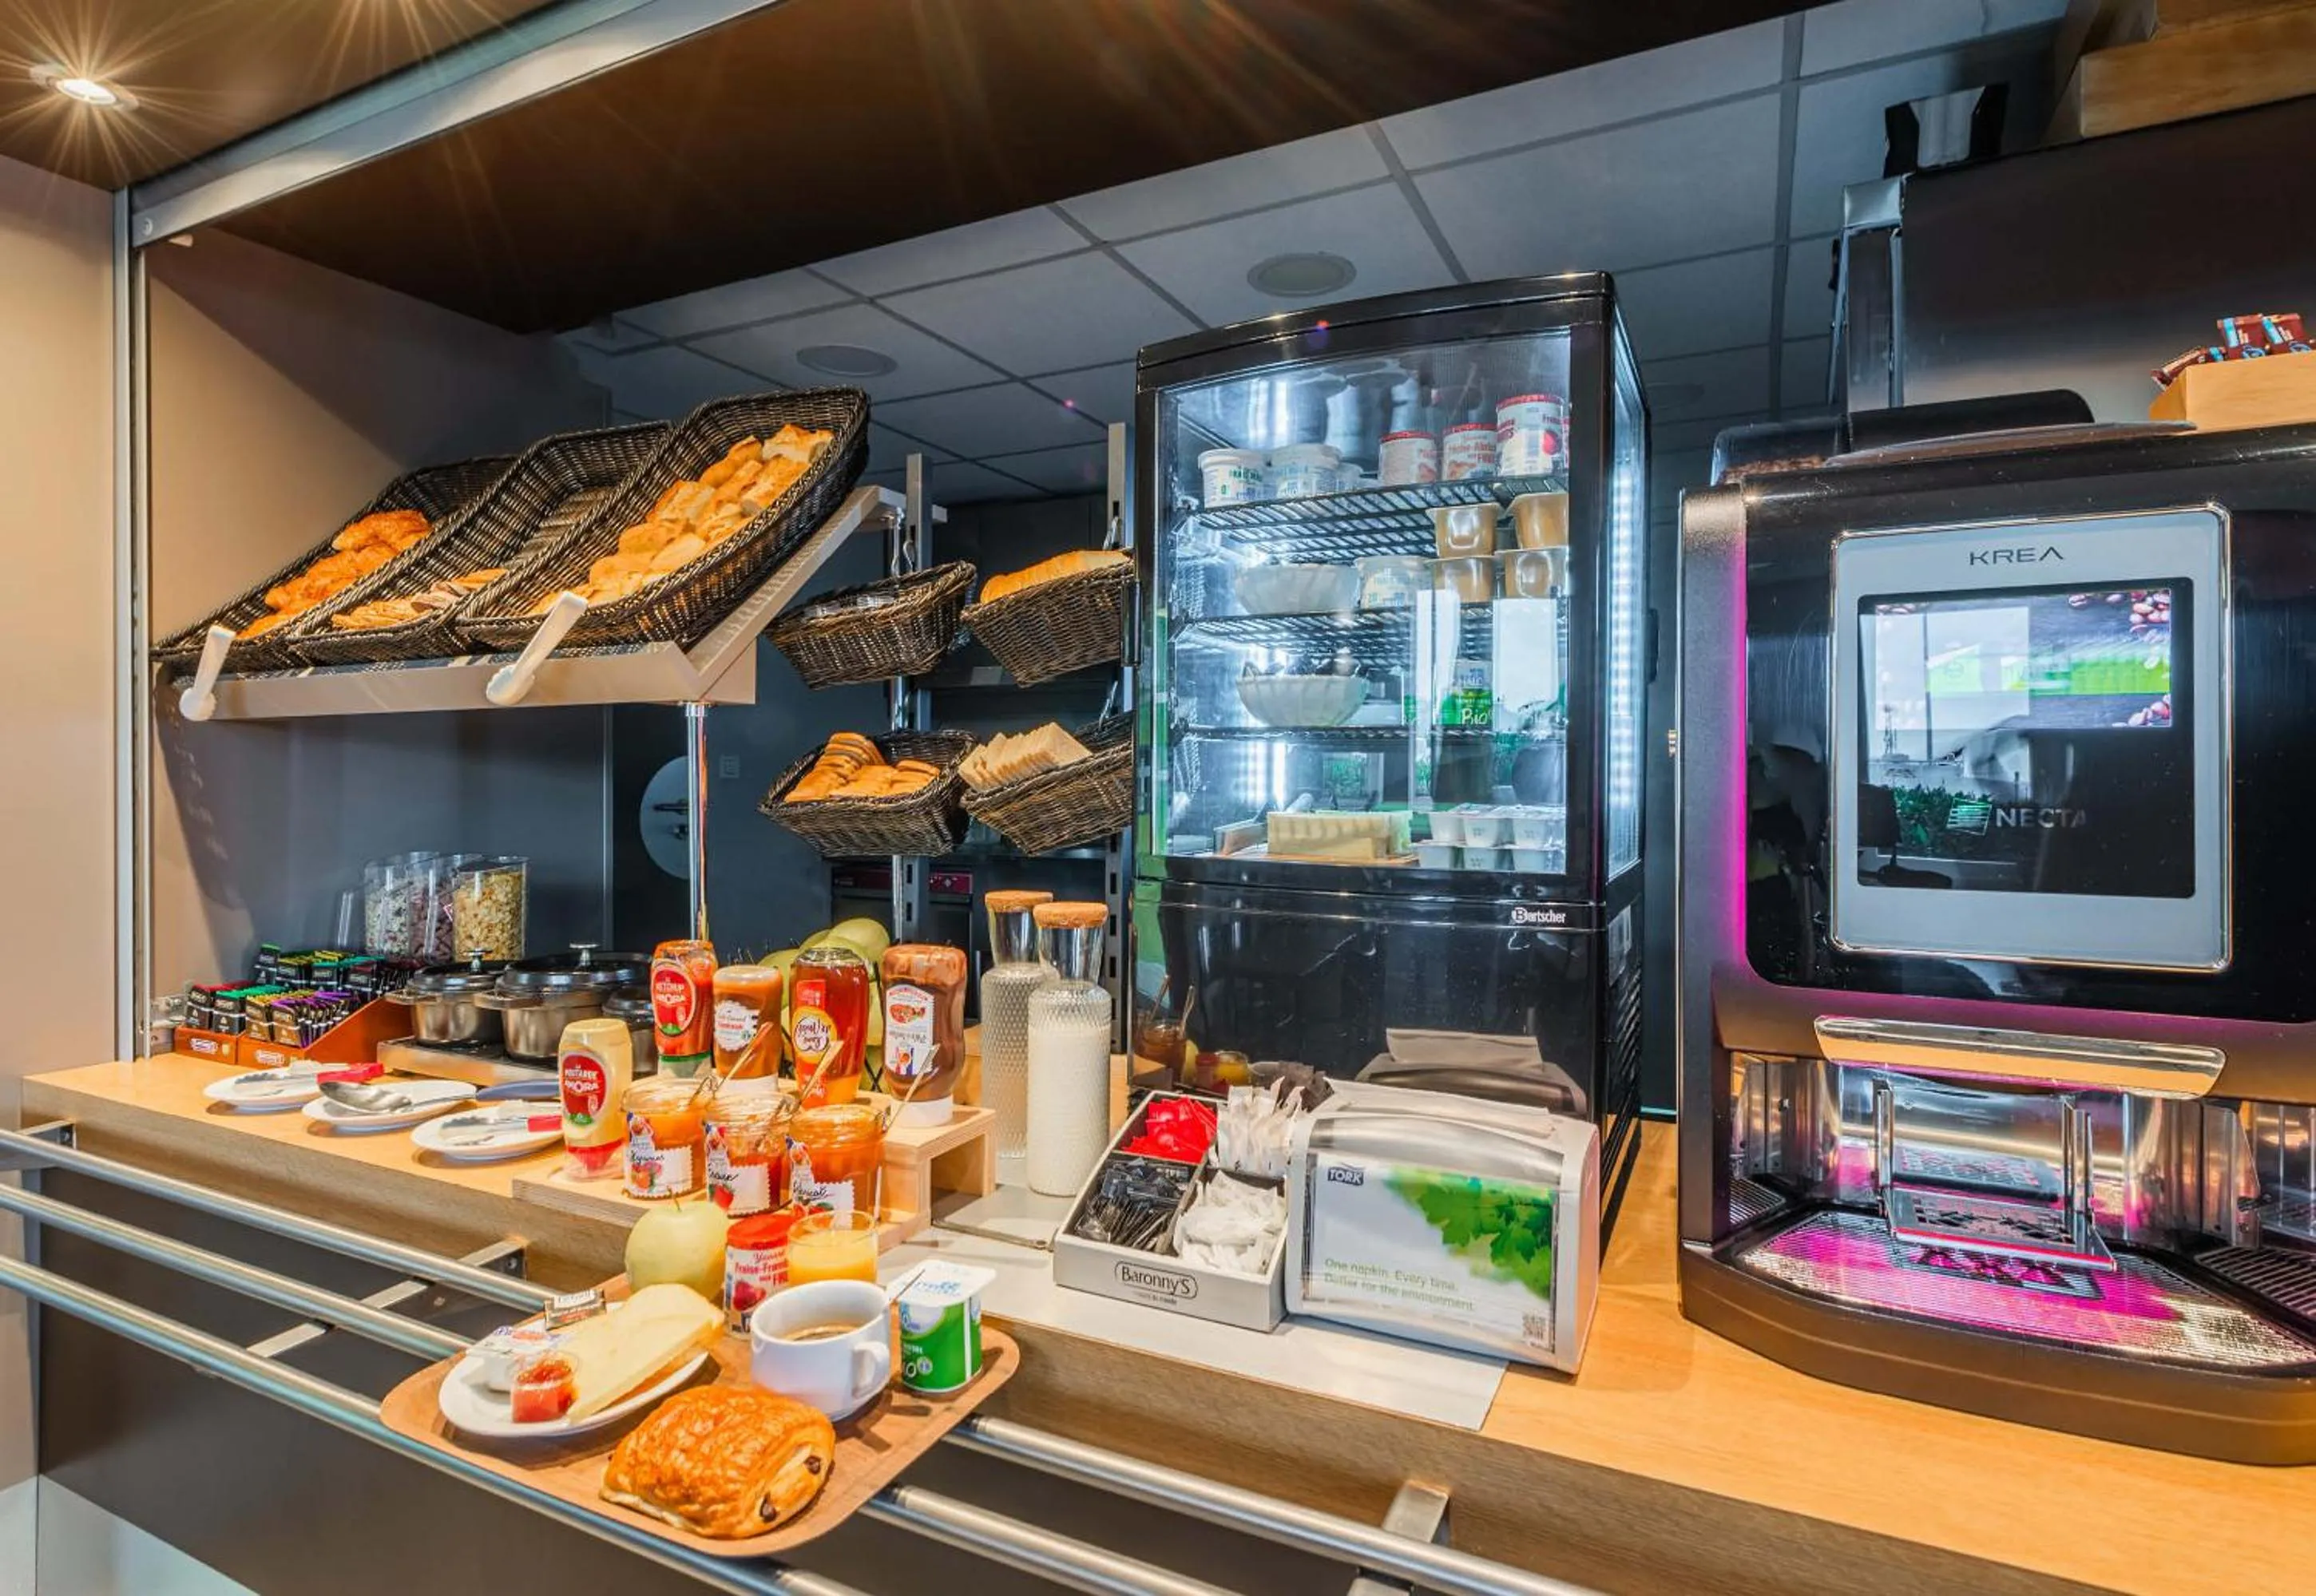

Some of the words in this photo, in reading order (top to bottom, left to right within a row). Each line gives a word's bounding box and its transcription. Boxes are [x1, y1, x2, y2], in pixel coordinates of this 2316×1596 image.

[1969, 546, 2064, 566] KREA
[1996, 807, 2086, 828] NECTA
[1512, 907, 1566, 923] Bartscher
[1329, 1168, 1362, 1185] TORK
[1325, 1257, 1348, 1270] One
